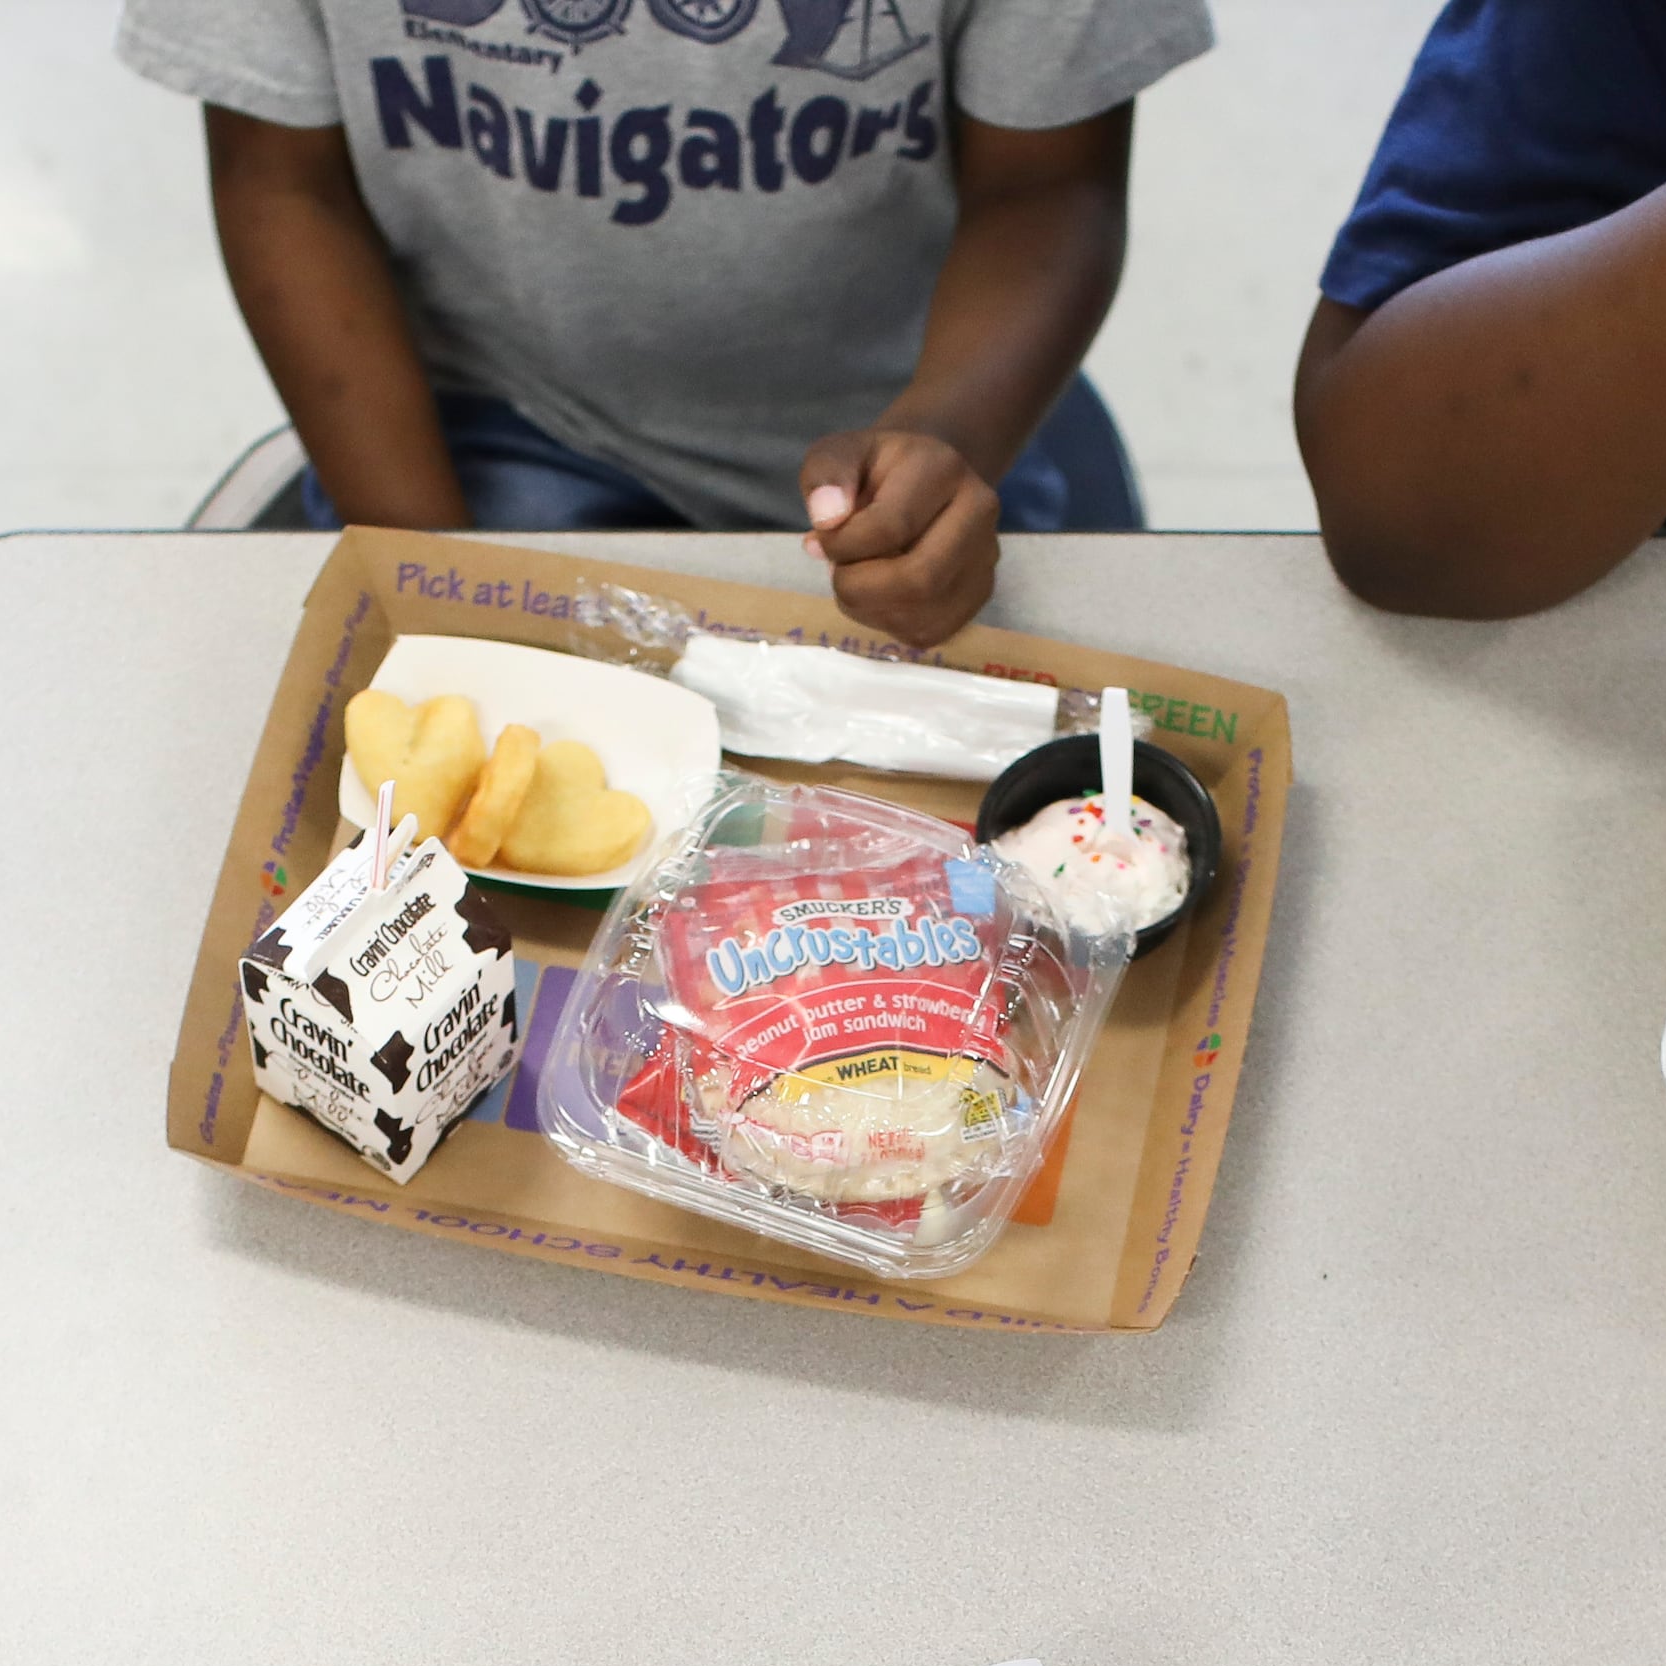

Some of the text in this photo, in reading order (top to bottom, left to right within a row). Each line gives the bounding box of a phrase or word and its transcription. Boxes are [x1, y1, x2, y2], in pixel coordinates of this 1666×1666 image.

[403, 19, 565, 73] Elementary
[370, 54, 934, 227] Navigators
[397, 561, 514, 610] Pick at
[349, 932, 390, 978] Cravin'
[380, 893, 437, 945] Chocolate
[780, 898, 902, 923] SMUCKER'S
[370, 922, 448, 1003] Chocolate
[405, 950, 454, 1010] Milk
[280, 997, 353, 1064] Cravin'
[415, 993, 498, 1093] Chocolate
[423, 969, 483, 1055] Cravin'
[735, 1012, 799, 1057] peanut
[802, 993, 867, 1024] butter
[873, 994, 887, 1009] &
[802, 1012, 927, 1045] jam sandwich
[270, 1017, 372, 1105] Chocolate
[835, 1055, 932, 1082] WHEAT bread
[1156, 1071, 1210, 1245] Dairy Healthy
[412, 1209, 879, 1306] HEALTHY SCHOOL
